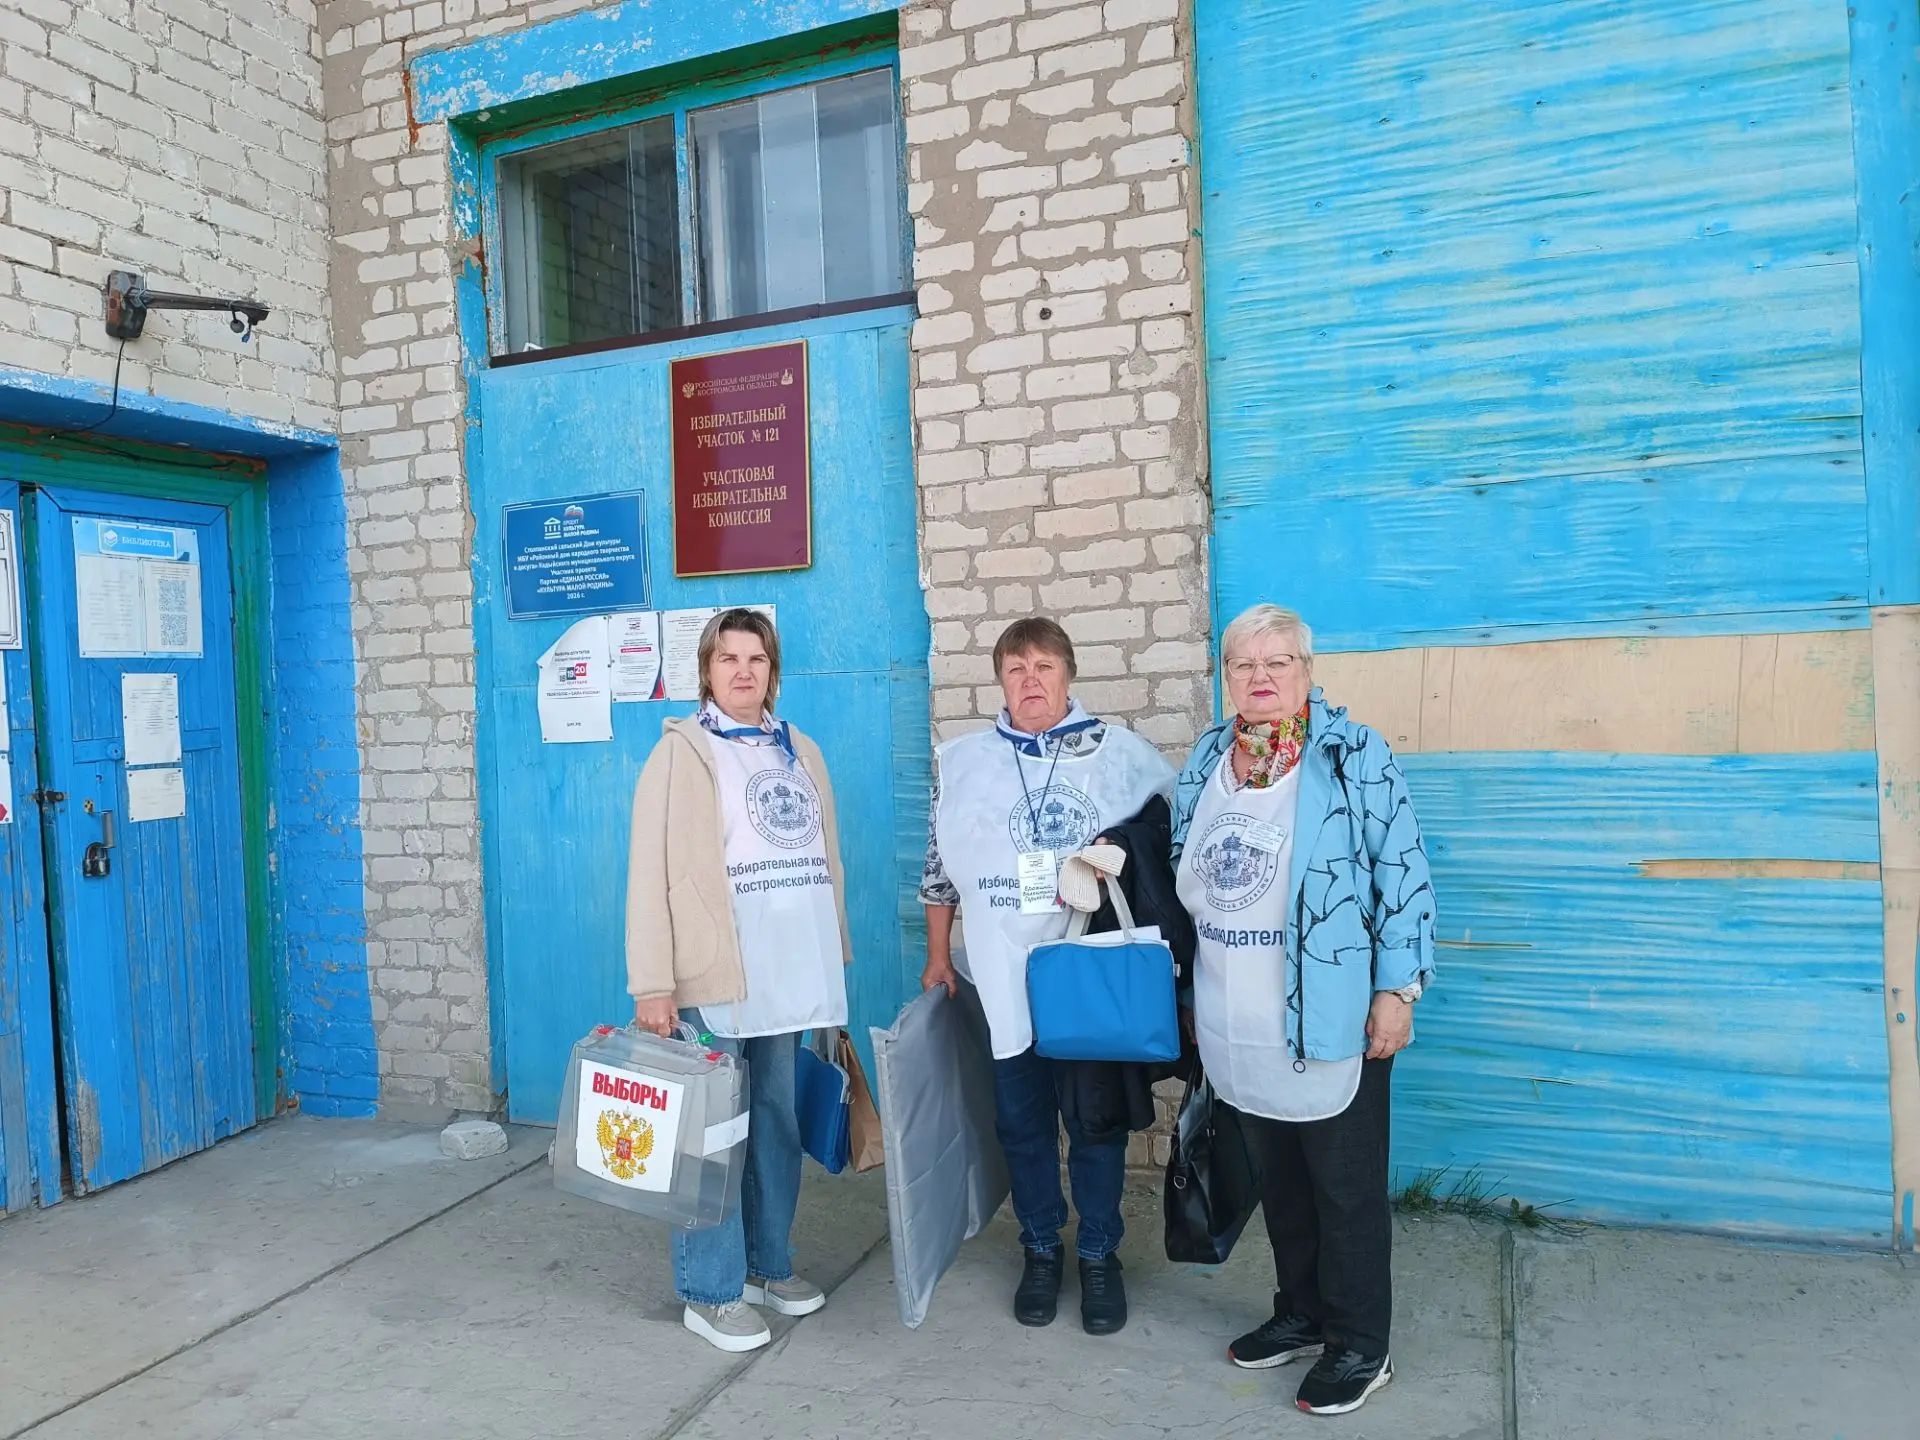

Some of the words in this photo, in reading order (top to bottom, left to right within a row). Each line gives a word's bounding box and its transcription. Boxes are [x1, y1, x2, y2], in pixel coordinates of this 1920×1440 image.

[695, 376, 738, 392] РОССИЙСКАЯ
[738, 371, 780, 385] ФЕДЕРАЦИЯ
[697, 383, 745, 397] КОСТРОМСКАЯ
[746, 379, 778, 391] ОБЛАСТЬ
[691, 403, 787, 431] ИЗБИРАТЕЛЬНЫЙ
[697, 430, 746, 449] УЧАСТОК
[751, 429, 762, 443] №
[765, 428, 779, 442] 121
[703, 465, 775, 487] УЧАСТКОВАЯ
[693, 485, 787, 508] ИЗБИРАТЕЛЬНАЯ
[708, 508, 772, 528] КОМИССИЯ
[122, 535, 172, 549] БИБЛИОТЕКА
[567, 582, 587, 591] МАЛОЙ
[575, 666, 586, 674] 20
[811, 857, 827, 867] ком
[735, 873, 811, 895] Костромской
[813, 874, 832, 885] обла
[978, 875, 1020, 890] Избира
[990, 895, 1020, 909] Костр
[1198, 918, 1284, 948] Наблюдател
[592, 1071, 668, 1112] ВЫБОРЫ
